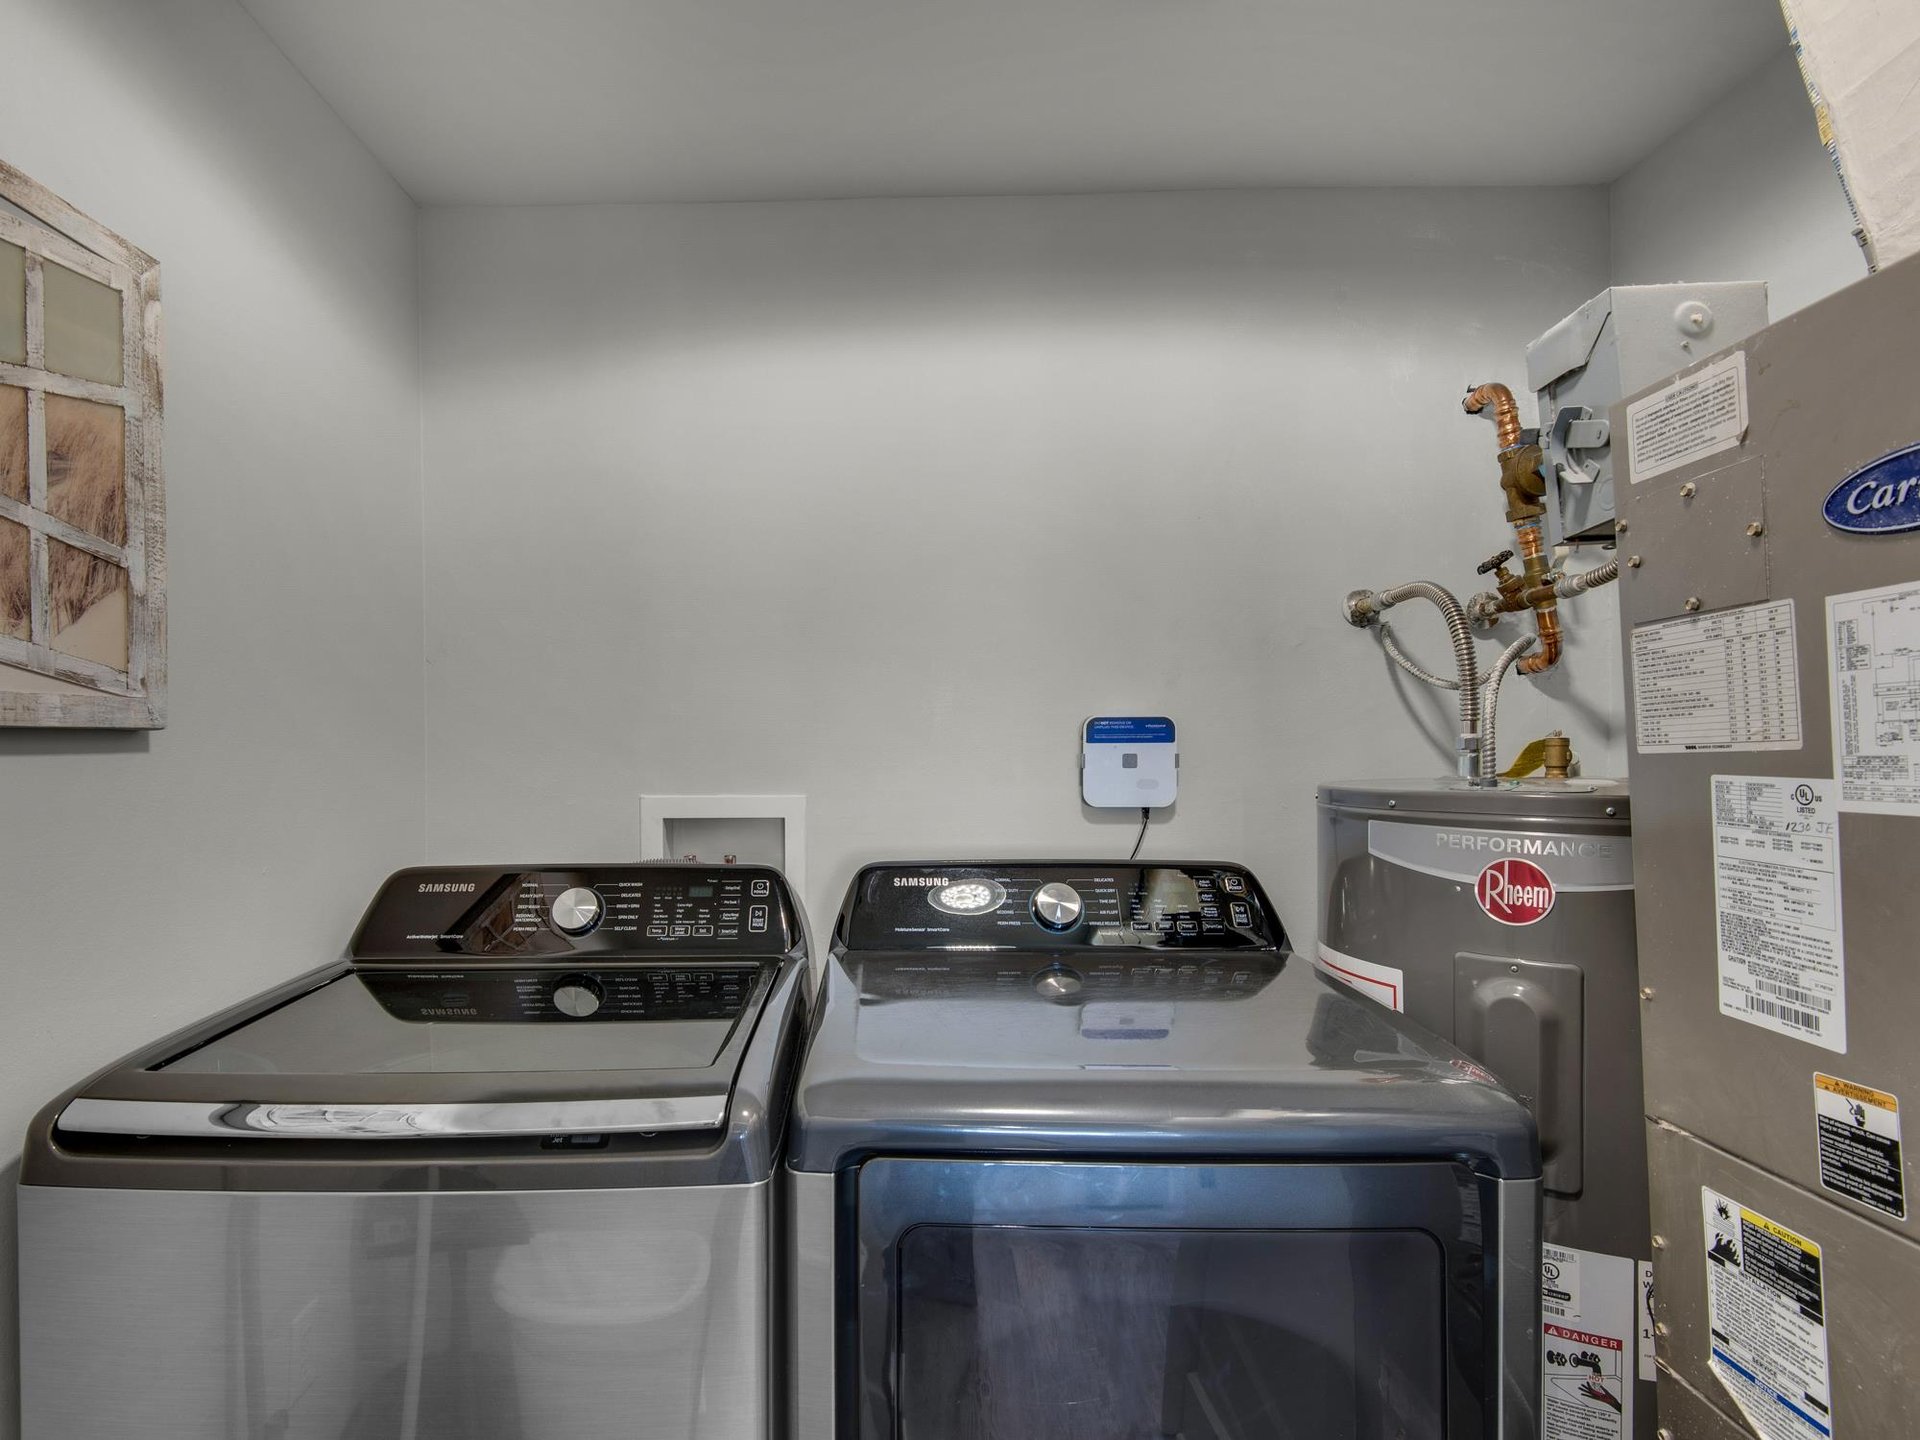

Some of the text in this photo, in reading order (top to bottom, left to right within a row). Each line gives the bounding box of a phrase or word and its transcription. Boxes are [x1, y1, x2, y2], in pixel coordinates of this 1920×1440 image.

[1848, 474, 1920, 516] Car
[1796, 806, 1816, 814] LISTED
[1436, 833, 1614, 859] PERFORMANCE
[418, 883, 476, 893] SAMSUNG
[893, 877, 950, 887] SAMSUNG
[1485, 860, 1549, 914] Rheem
[1832, 1085, 1885, 1107] AVERTISSEMENT
[1843, 1082, 1874, 1097] WARNING
[1772, 1226, 1801, 1246] CAUTION
[1738, 1269, 1781, 1300] INSTALLATION
[1562, 1328, 1618, 1350] DANGER
[1751, 1355, 1777, 1379] SERVICE
[1588, 1375, 1605, 1383] HOT
